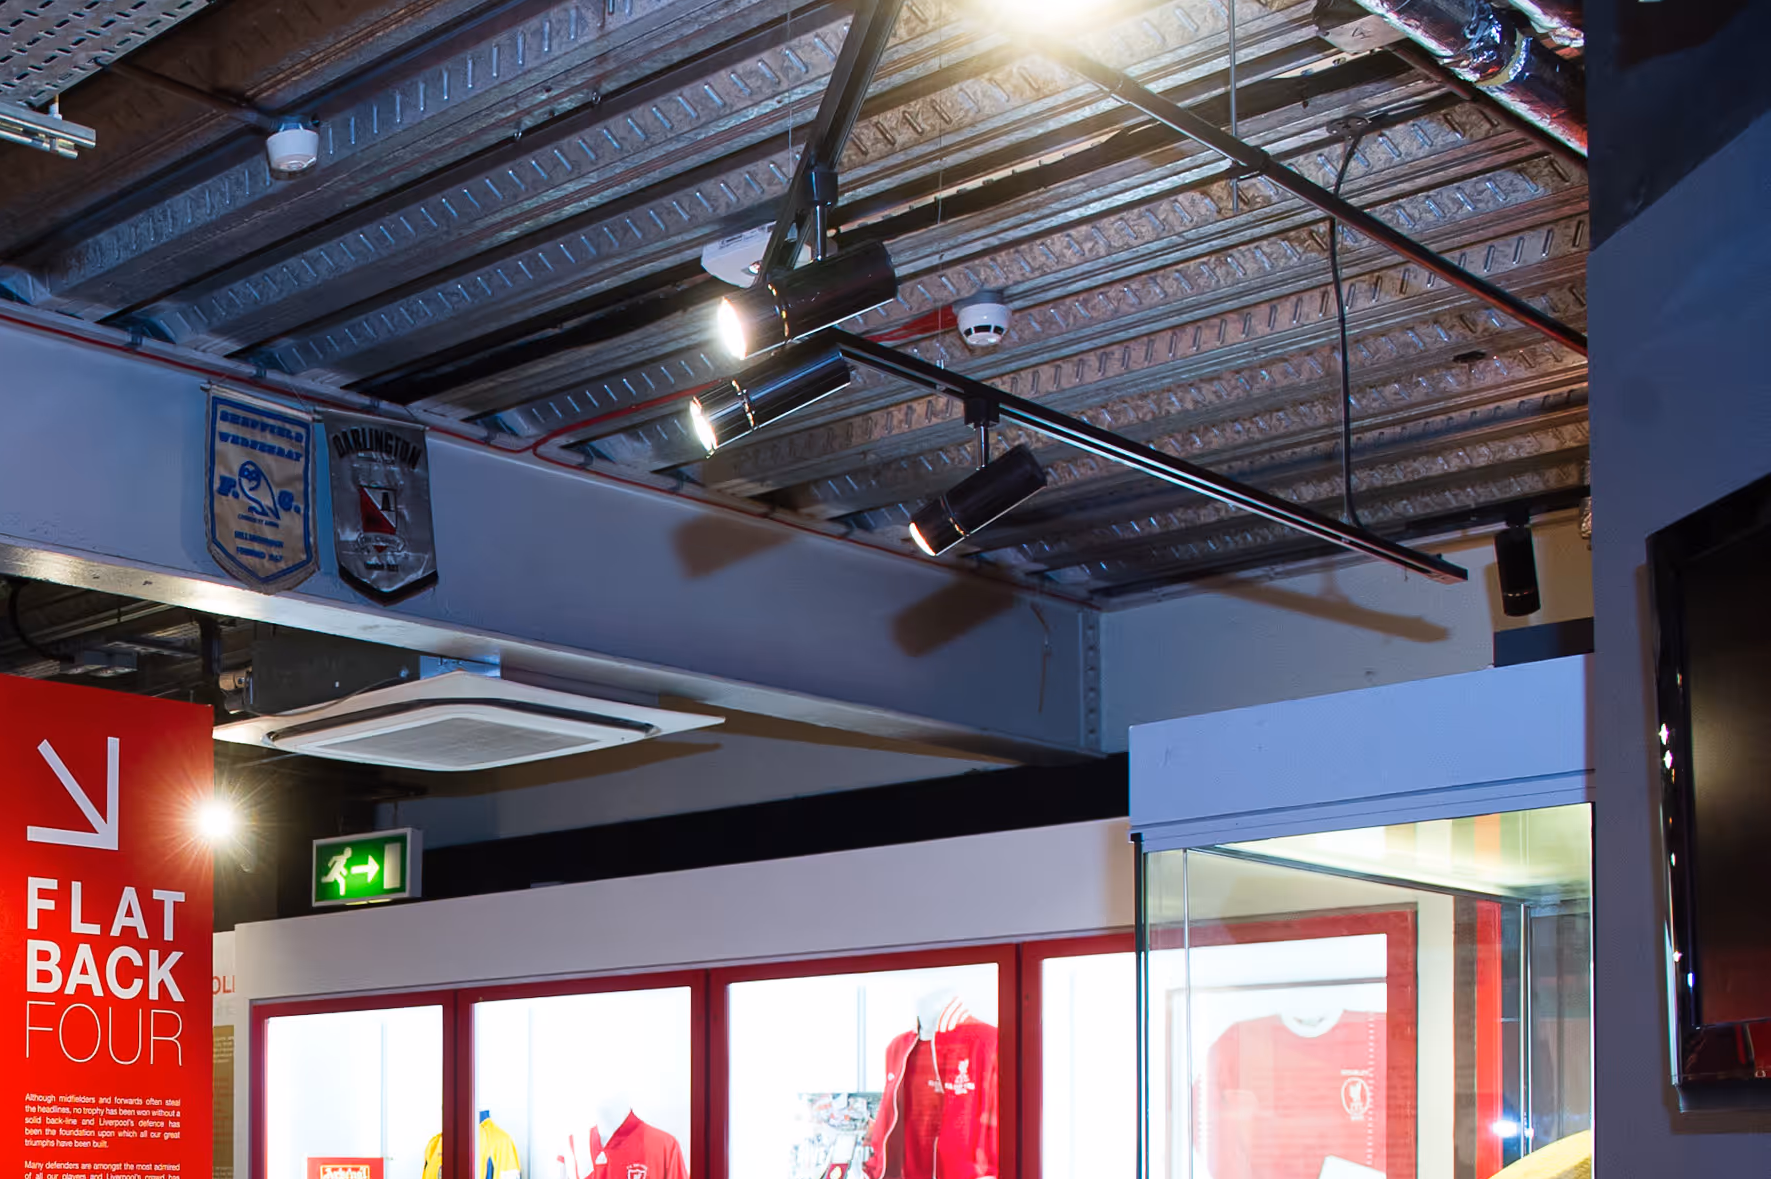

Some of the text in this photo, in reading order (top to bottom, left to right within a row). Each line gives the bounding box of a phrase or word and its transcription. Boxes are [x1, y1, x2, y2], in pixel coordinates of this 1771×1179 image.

[332, 426, 422, 470] DARLINGTON
[27, 877, 185, 941] FLAT
[27, 939, 185, 1002] BACK
[26, 1000, 182, 1066] FOUR
